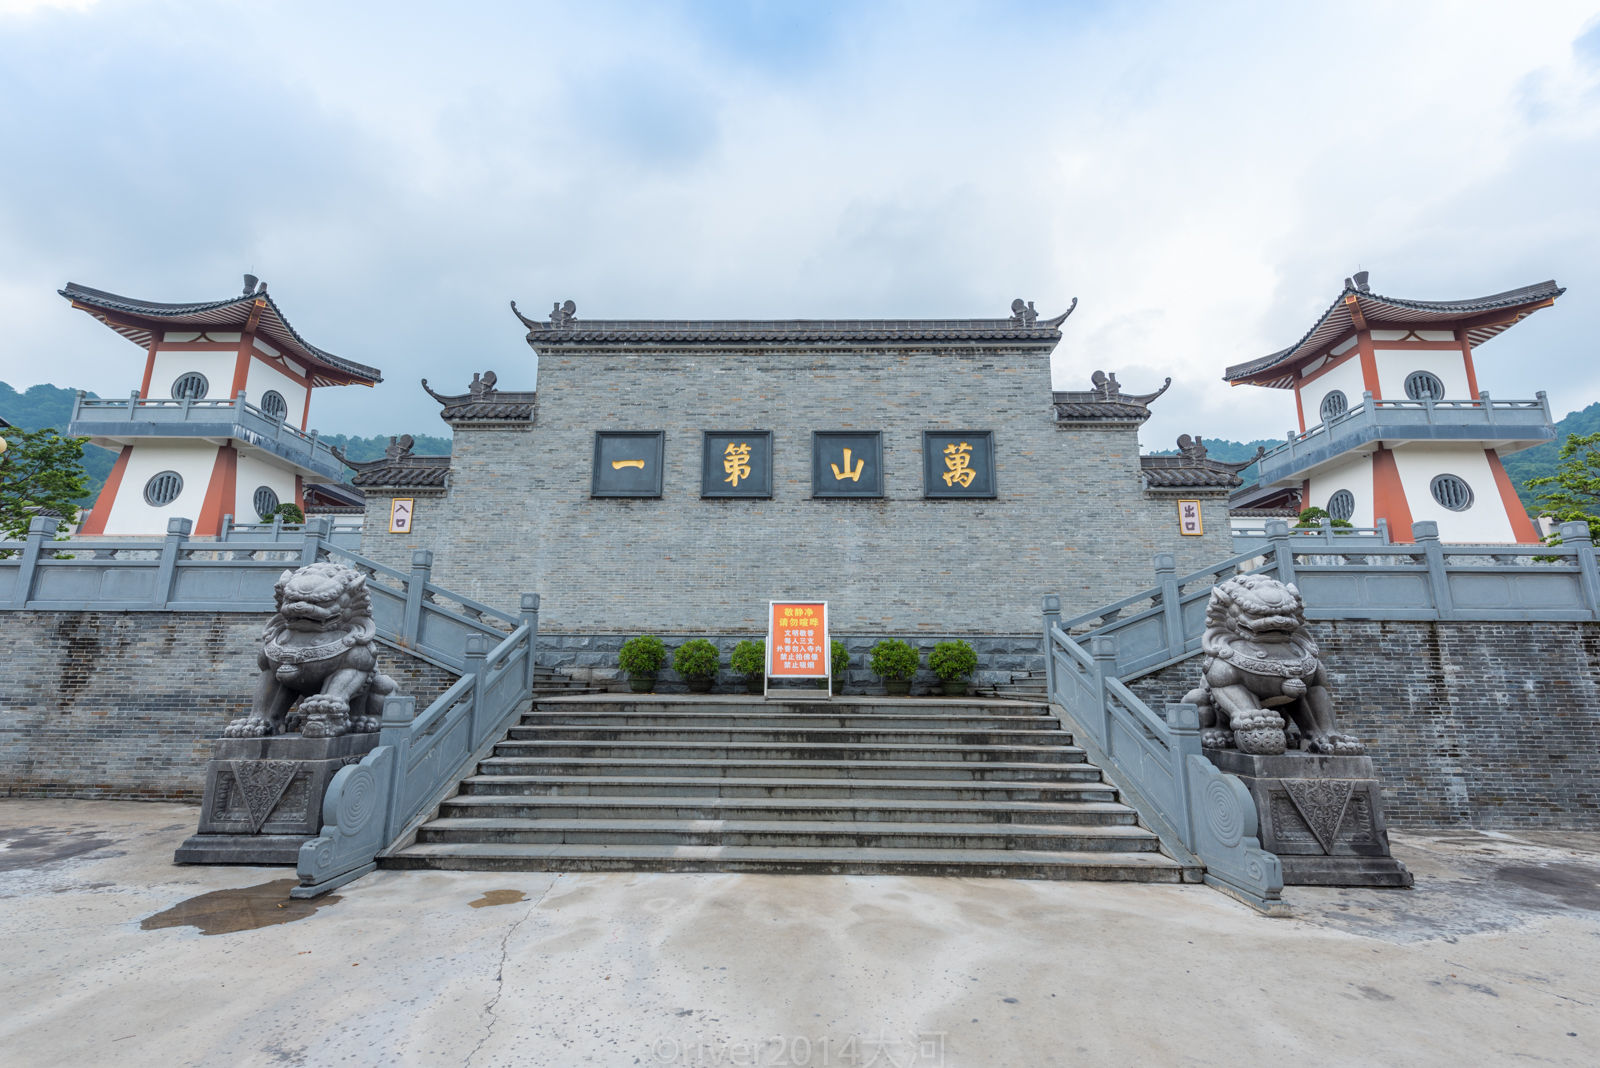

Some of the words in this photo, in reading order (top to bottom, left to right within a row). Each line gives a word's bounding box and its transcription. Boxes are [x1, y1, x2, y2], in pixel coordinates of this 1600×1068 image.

[395, 504, 409, 528] 入口
[1184, 504, 1196, 531] 出口
[779, 618, 819, 627] 请勿喧哗
[784, 629, 814, 637] 文明敬香
[784, 637, 814, 645] 每人三支
[776, 645, 822, 653] 外香勿入寺内
[783, 661, 815, 669] 禁止吸烟
